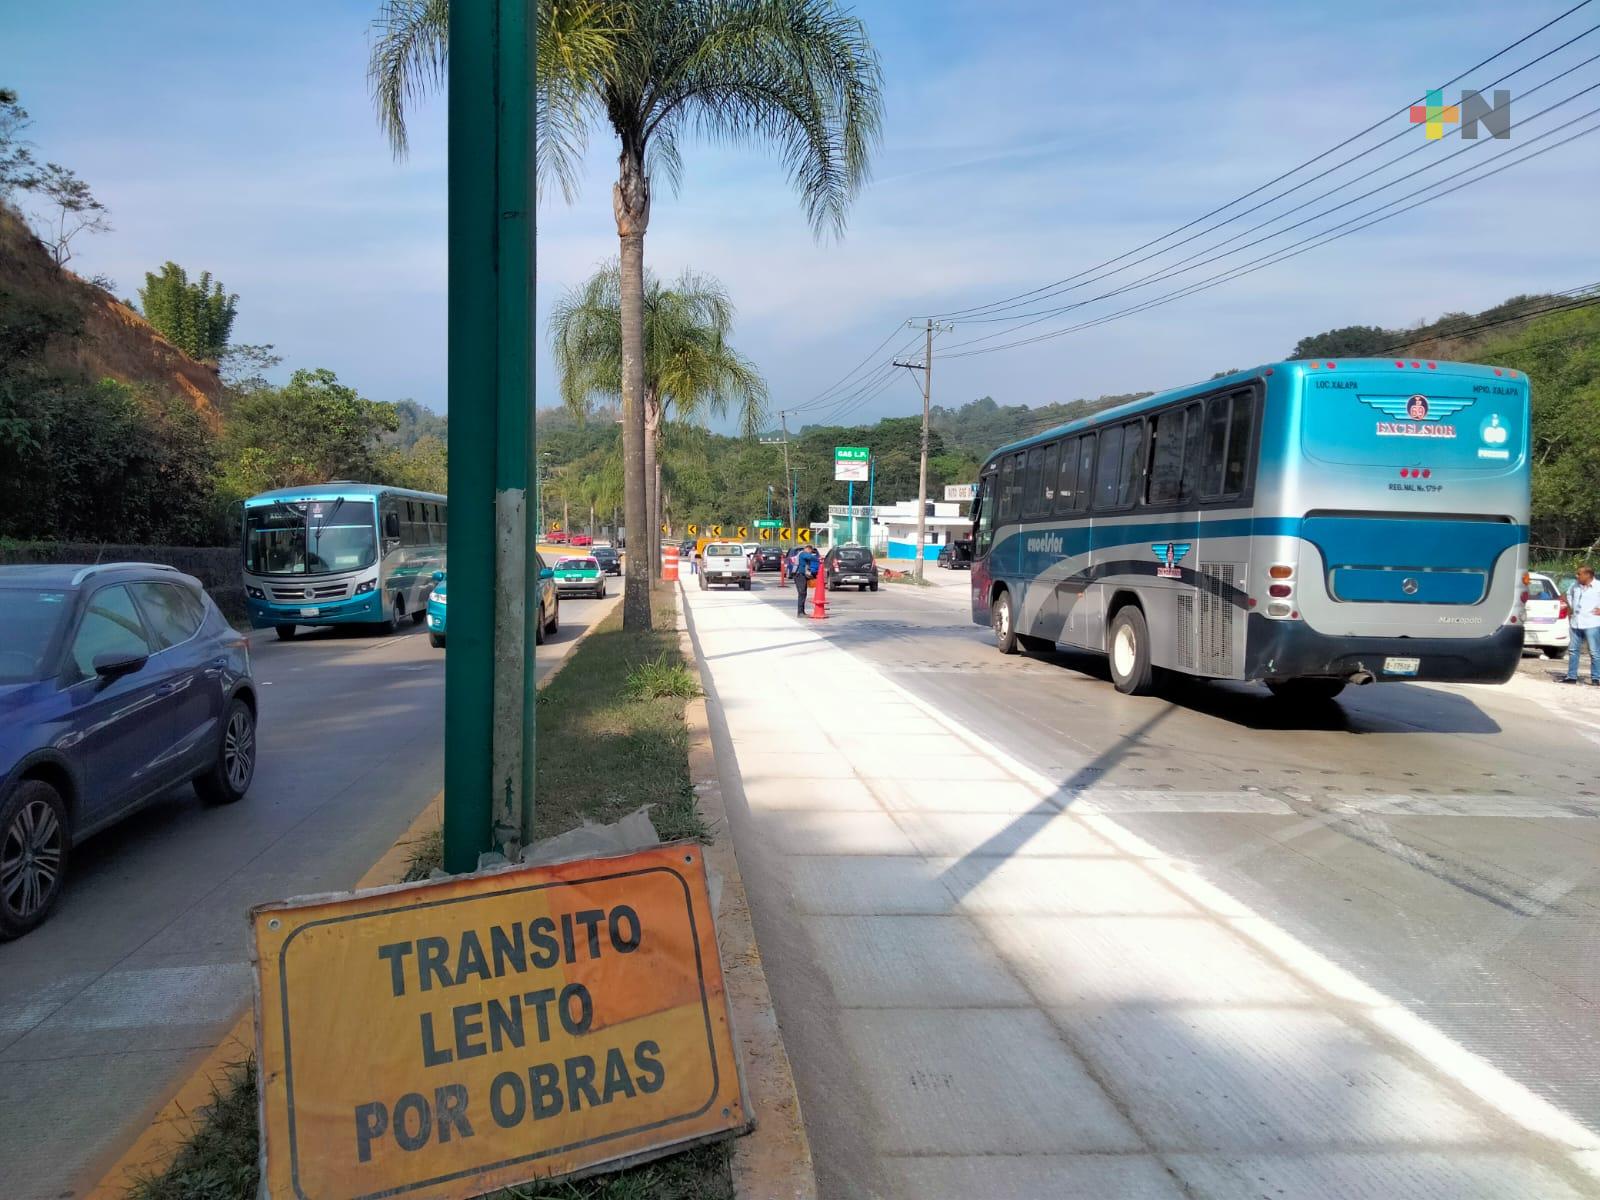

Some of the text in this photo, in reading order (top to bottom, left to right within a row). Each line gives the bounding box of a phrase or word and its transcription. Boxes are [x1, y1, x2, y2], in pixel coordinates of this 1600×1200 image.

[1376, 421, 1456, 438] EXCELSIOR
[378, 904, 642, 997] TRANSITO
[420, 982, 593, 1068] LENTO
[355, 1040, 665, 1163] POR OBRAS
